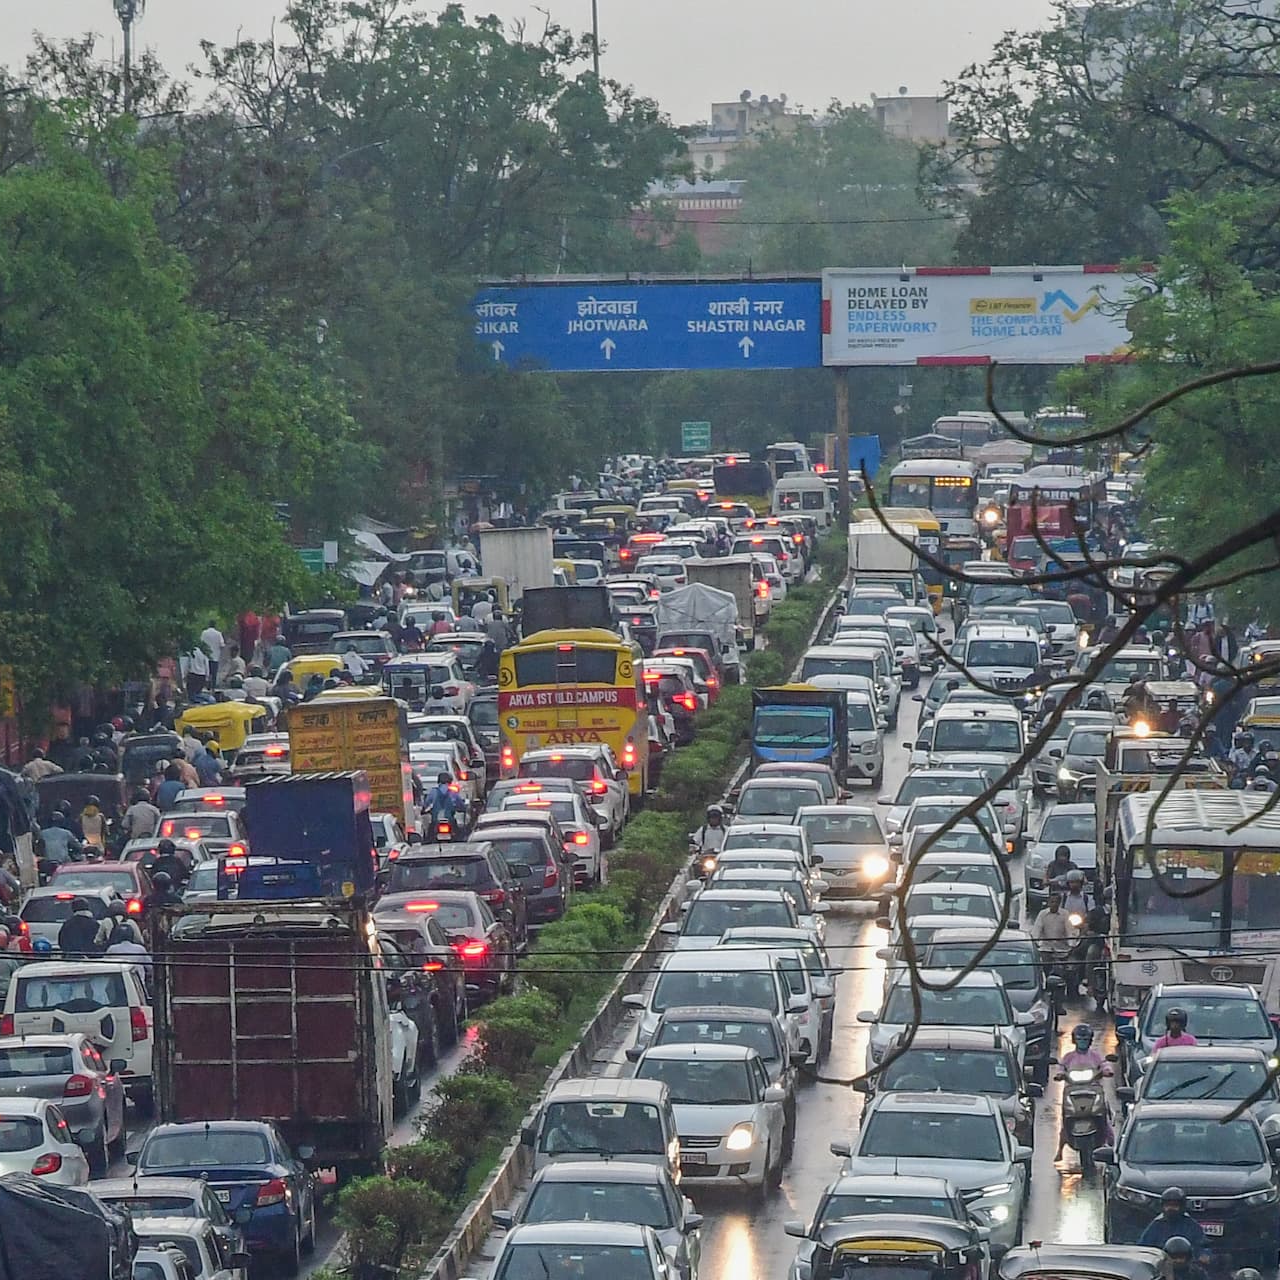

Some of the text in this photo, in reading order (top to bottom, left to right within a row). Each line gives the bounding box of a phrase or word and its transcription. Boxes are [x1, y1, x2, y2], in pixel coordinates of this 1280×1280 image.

[848, 287, 928, 298] HOME LOAN
[708, 297, 784, 316] शास्त्री नगर
[848, 299, 928, 309] DELAYED BY
[848, 311, 906, 321] ENDLESS
[971, 315, 1062, 325] THE COMPLETE
[475, 322, 518, 334] SIKAR
[567, 319, 648, 335] JHOTWARA
[687, 319, 806, 333] SHASTRI NAGAR
[848, 322, 936, 333] PAPERWORK?
[971, 325, 1062, 336] HOME LOAN
[509, 693, 534, 706] ARYA
[576, 691, 618, 702] CAMPUS
[546, 732, 602, 744] ARYA
